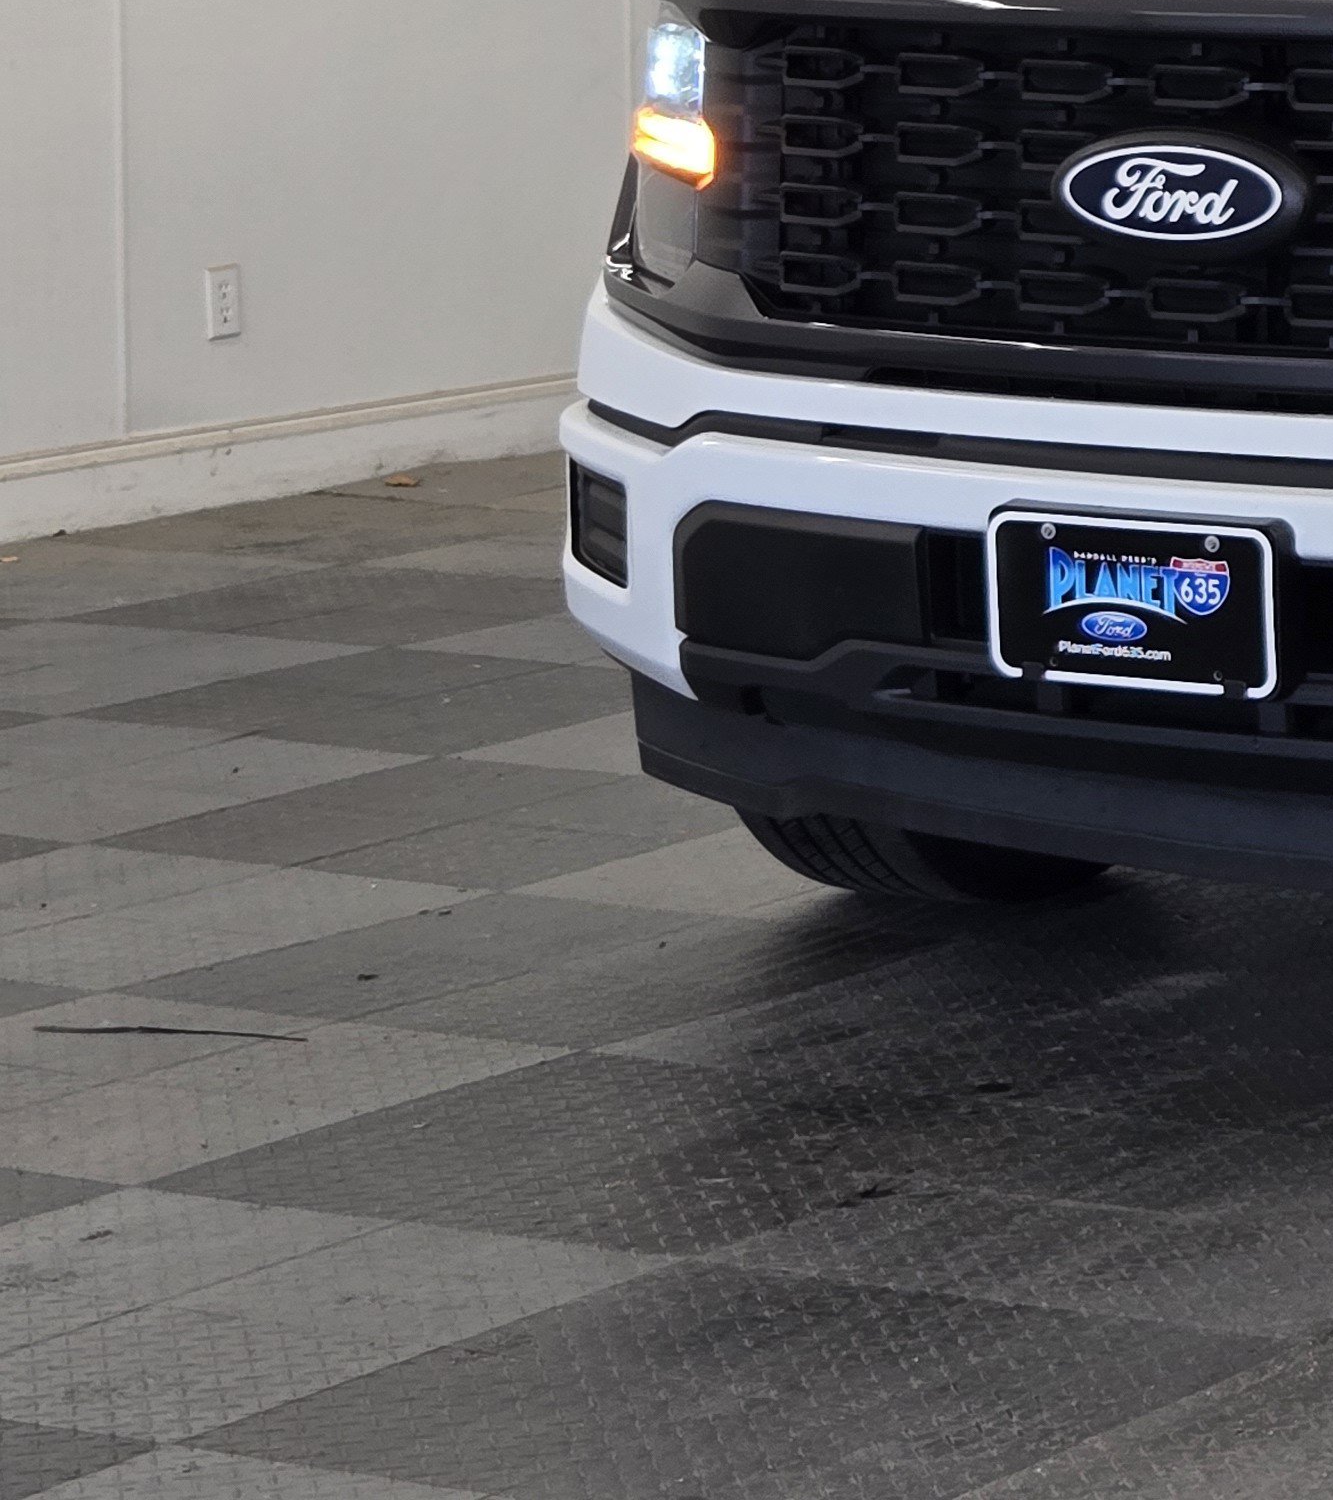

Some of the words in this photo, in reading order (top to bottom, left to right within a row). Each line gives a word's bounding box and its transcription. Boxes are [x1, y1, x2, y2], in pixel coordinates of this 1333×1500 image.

[1102, 157, 1239, 225] Ford
[1047, 546, 1179, 616] PLANET
[1180, 577, 1221, 606] 635
[1094, 615, 1136, 638] Ford
